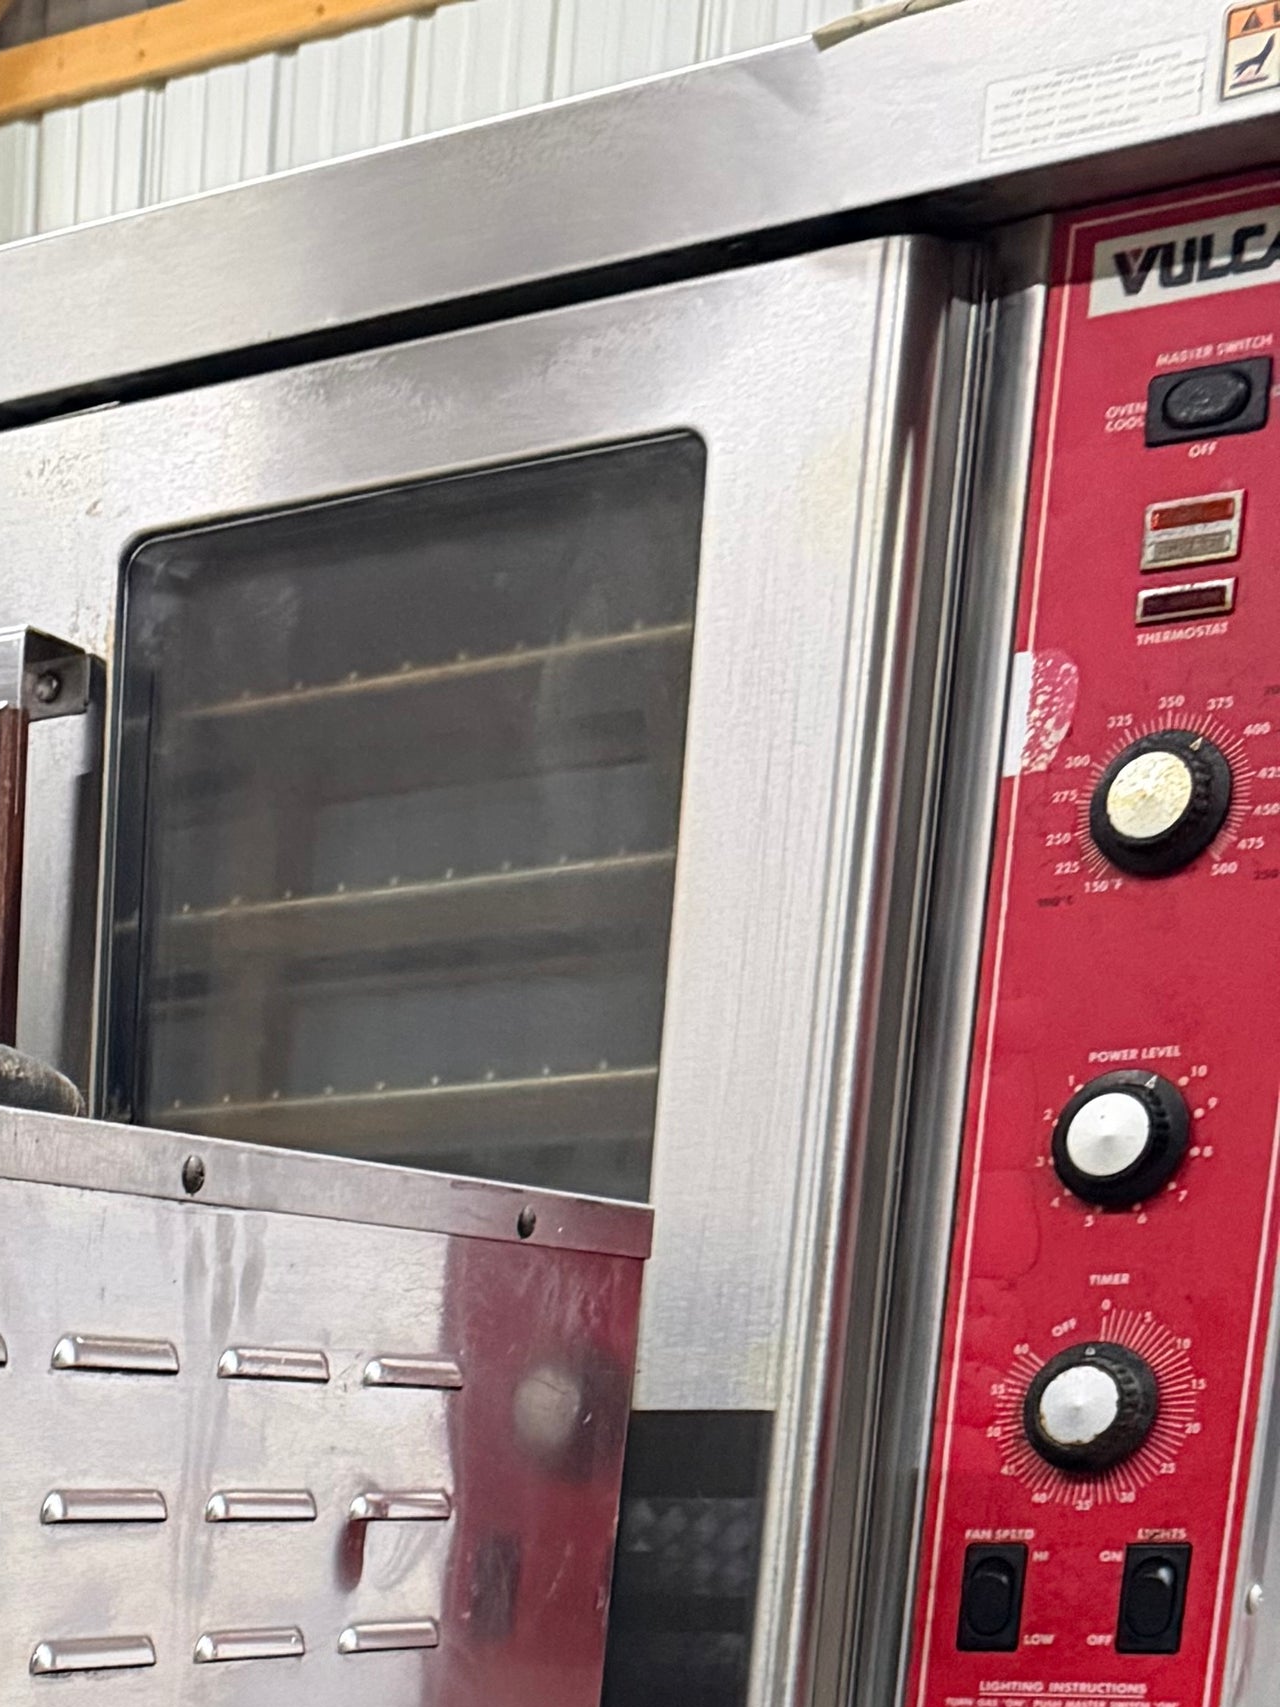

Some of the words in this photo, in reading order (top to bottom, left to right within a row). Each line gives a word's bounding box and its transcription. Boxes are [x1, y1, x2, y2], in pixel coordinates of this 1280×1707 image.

[1156, 344, 1213, 367] MASTER
[1217, 333, 1273, 357] SWITCH
[1188, 441, 1217, 457] OFF
[1136, 621, 1228, 646] THERMOSTAT
[1158, 695, 1185, 709] 350
[1207, 696, 1233, 710] 375
[1107, 714, 1133, 729] 325
[1243, 722, 1271, 737] 400
[1064, 754, 1091, 768] 300
[1052, 789, 1078, 804] 275
[1252, 805, 1280, 817] 450
[1045, 833, 1071, 846] 250
[1237, 837, 1265, 850] 475
[1055, 861, 1080, 875] 225
[1211, 861, 1238, 876] 500
[1089, 1048, 1138, 1063] POWER
[1141, 1045, 1182, 1059] LEVEL
[1191, 1065, 1207, 1077] 10
[1208, 1097, 1218, 1108] 9
[1043, 1108, 1053, 1120] 2
[1202, 1146, 1214, 1158] 8
[1178, 1190, 1188, 1202] 7
[1050, 1197, 1060, 1208] 4
[1084, 1215, 1094, 1227] 5
[1137, 1213, 1147, 1224] 6
[1089, 1273, 1130, 1285] TIMER
[1101, 1299, 1111, 1310] 0
[1051, 1318, 1077, 1337] OFF
[1013, 1343, 1030, 1355] 60
[1176, 1338, 1191, 1350] 10
[1191, 1379, 1206, 1390] 15
[1185, 1423, 1201, 1434] 20
[1160, 1463, 1176, 1474] 25
[965, 1529, 990, 1540] FAN
[995, 1529, 1035, 1540] SPEED
[1033, 1551, 1049, 1562] HI
[1099, 1551, 1123, 1562] ON
[1024, 1634, 1055, 1645] LOW
[1087, 1635, 1112, 1645] OFF
[979, 1681, 1043, 1692] LIGHTING
[1048, 1683, 1147, 1694] INSTRUCTIONS
